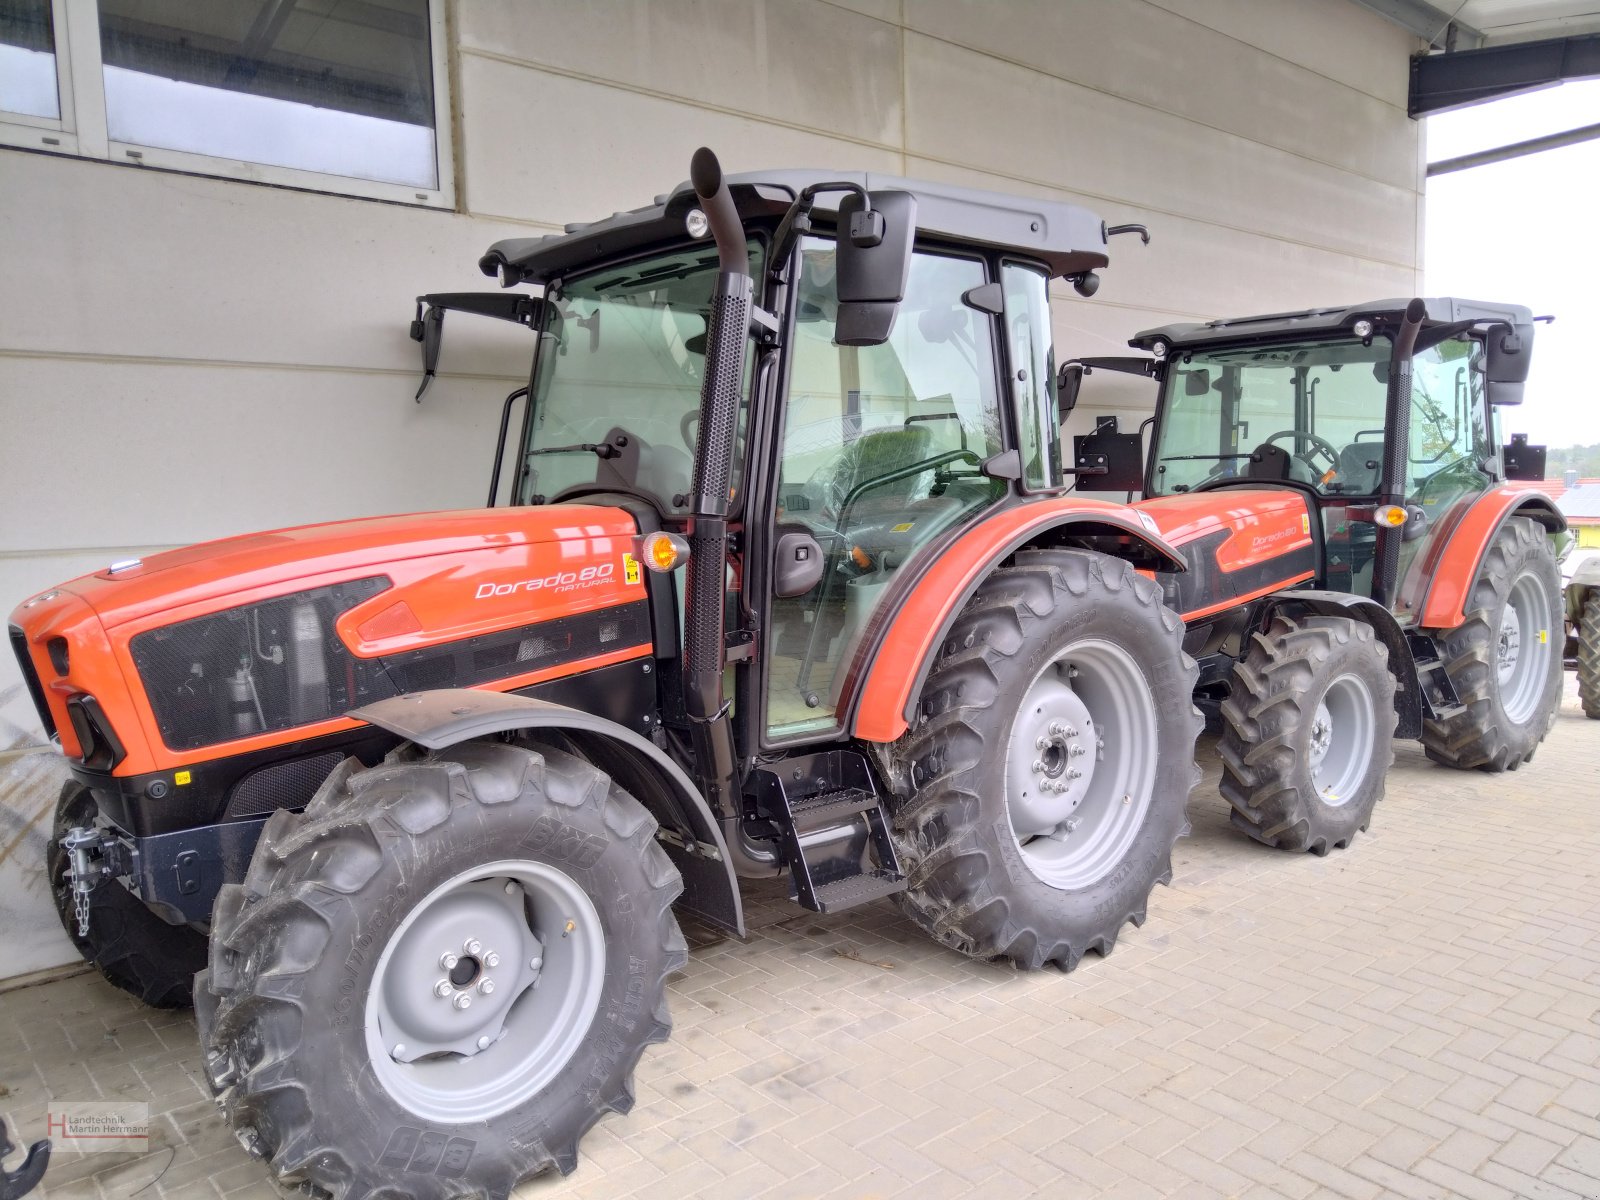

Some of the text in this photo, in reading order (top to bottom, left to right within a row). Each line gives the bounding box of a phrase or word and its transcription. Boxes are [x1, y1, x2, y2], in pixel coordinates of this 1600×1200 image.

[1252, 526, 1297, 546] Dorado 80
[475, 563, 614, 599] Dorado 80
[554, 577, 617, 593] NATURAL
[521, 816, 608, 870] BKT
